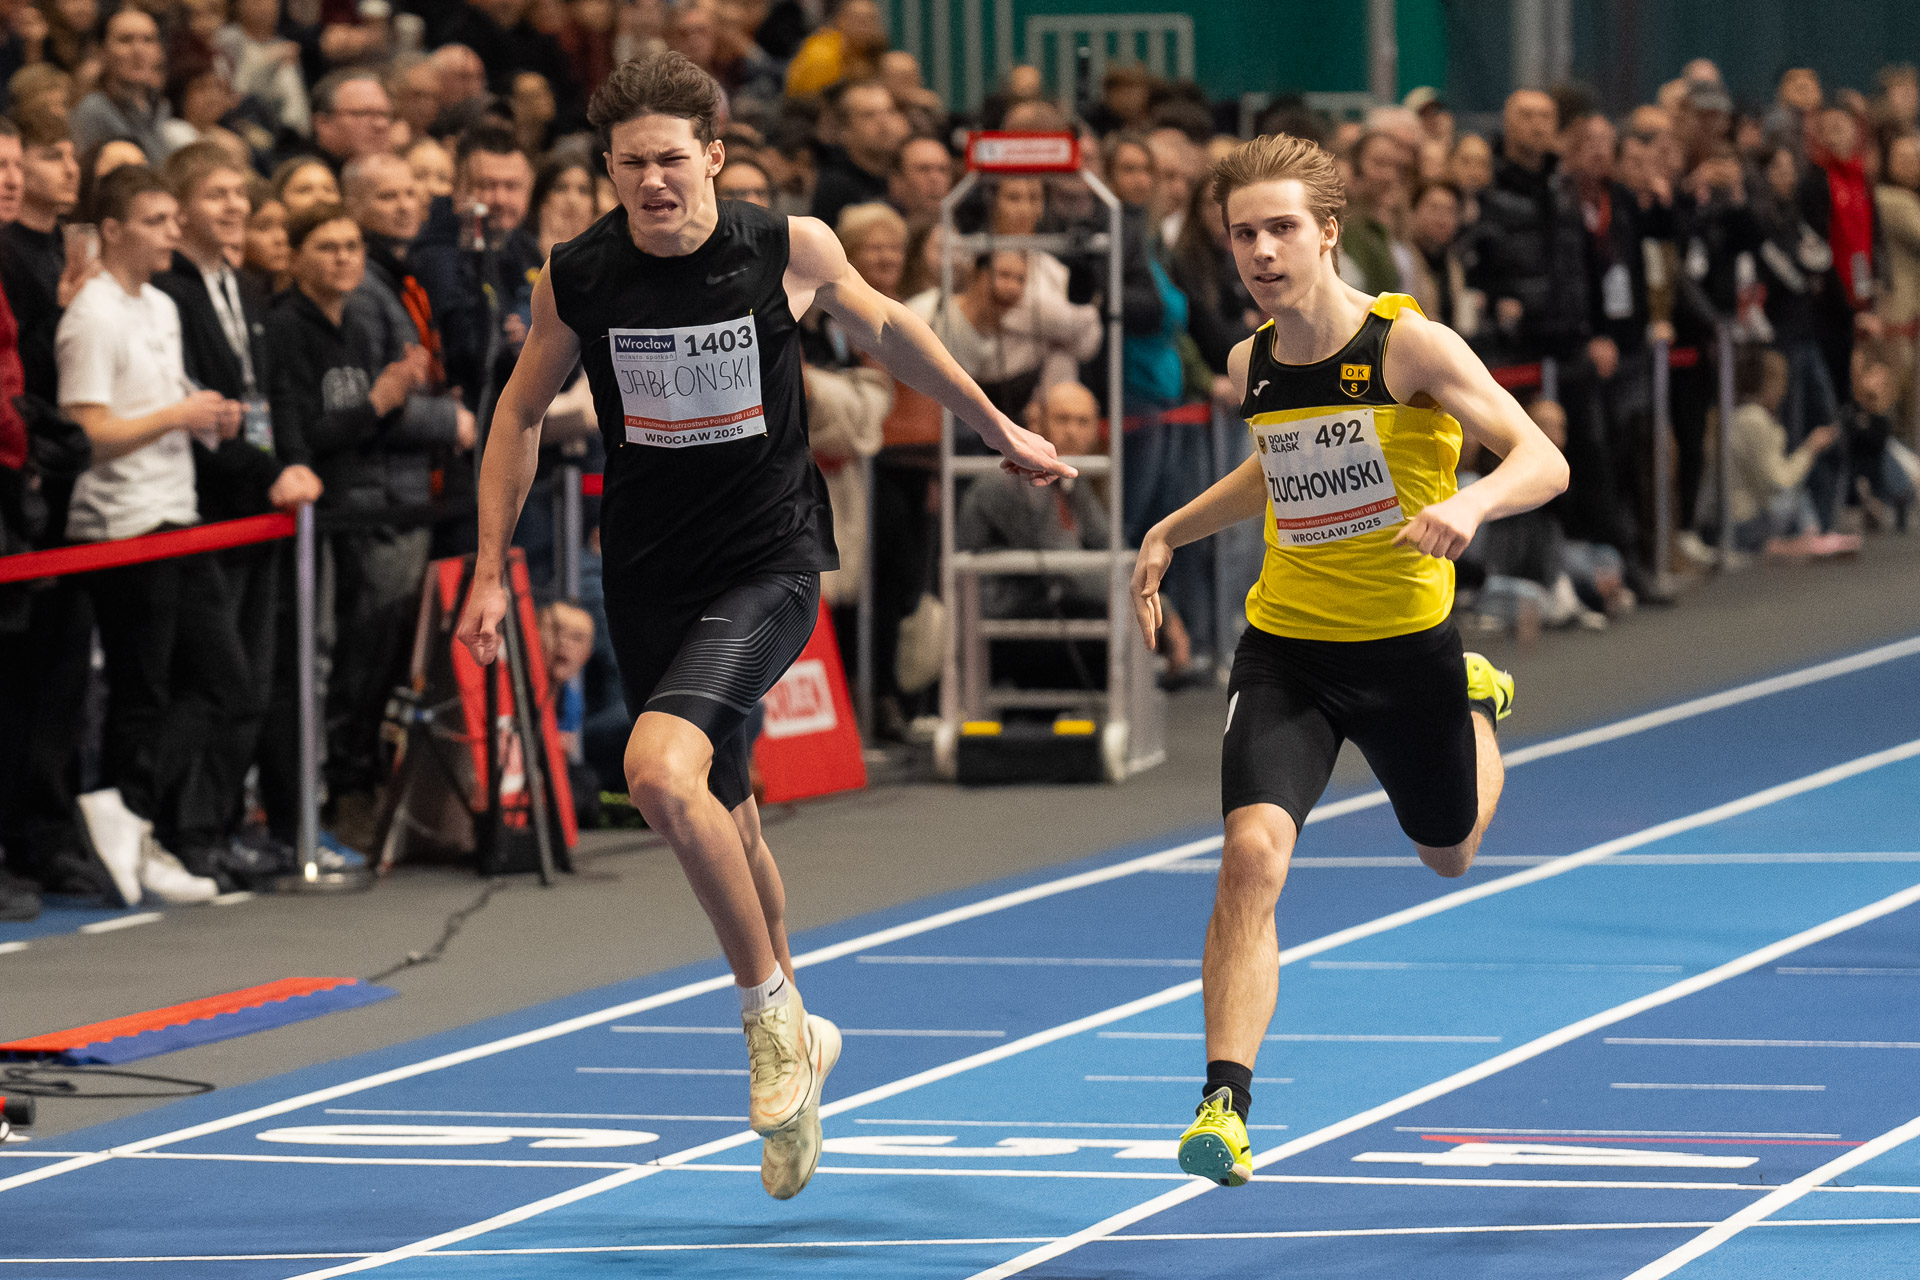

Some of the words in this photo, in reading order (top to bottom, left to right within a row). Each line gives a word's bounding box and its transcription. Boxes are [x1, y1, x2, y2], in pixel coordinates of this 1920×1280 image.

[618, 338, 672, 349] Wrocław
[684, 325, 753, 357] 1403
[621, 355, 752, 399] JABŁOŃSKI
[644, 420, 666, 429] Halowe
[667, 420, 709, 430] Mistrzostwa
[710, 417, 731, 425] Polski
[732, 413, 742, 422] U18
[747, 409, 760, 417] U20
[645, 431, 711, 445] WROCŁAW
[714, 425, 744, 440] 2025
[1268, 431, 1300, 444] DOLNY
[1315, 419, 1364, 448] 492
[1268, 459, 1384, 503] ŻUCHOWSKI
[1306, 515, 1344, 526] Mistrzostwa
[1344, 510, 1364, 520] Polski
[1365, 505, 1377, 514] U18
[1382, 499, 1396, 509] U20
[1291, 525, 1348, 543] WROCŁAW
[1351, 517, 1382, 533] 2025
